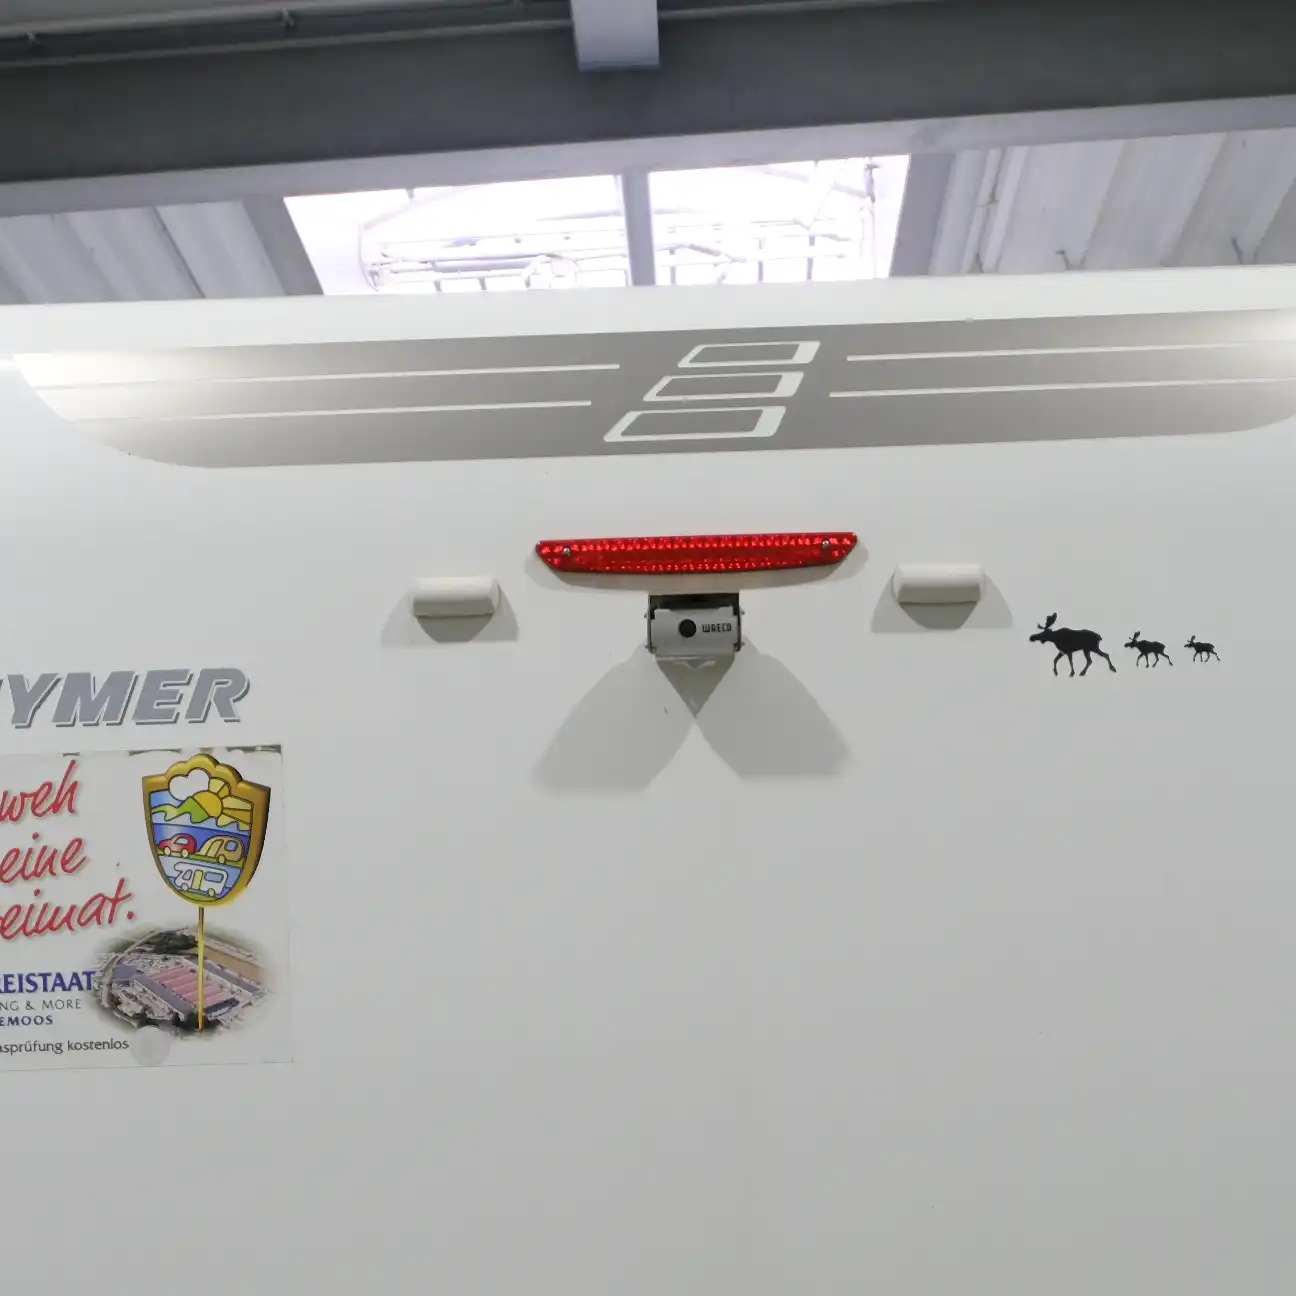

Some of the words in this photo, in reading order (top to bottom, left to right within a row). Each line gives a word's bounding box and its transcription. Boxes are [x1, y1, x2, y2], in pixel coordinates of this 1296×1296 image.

[25, 1000, 36, 1011] &
[41, 999, 82, 1011] MORE
[67, 1038, 130, 1051] kostenlos
